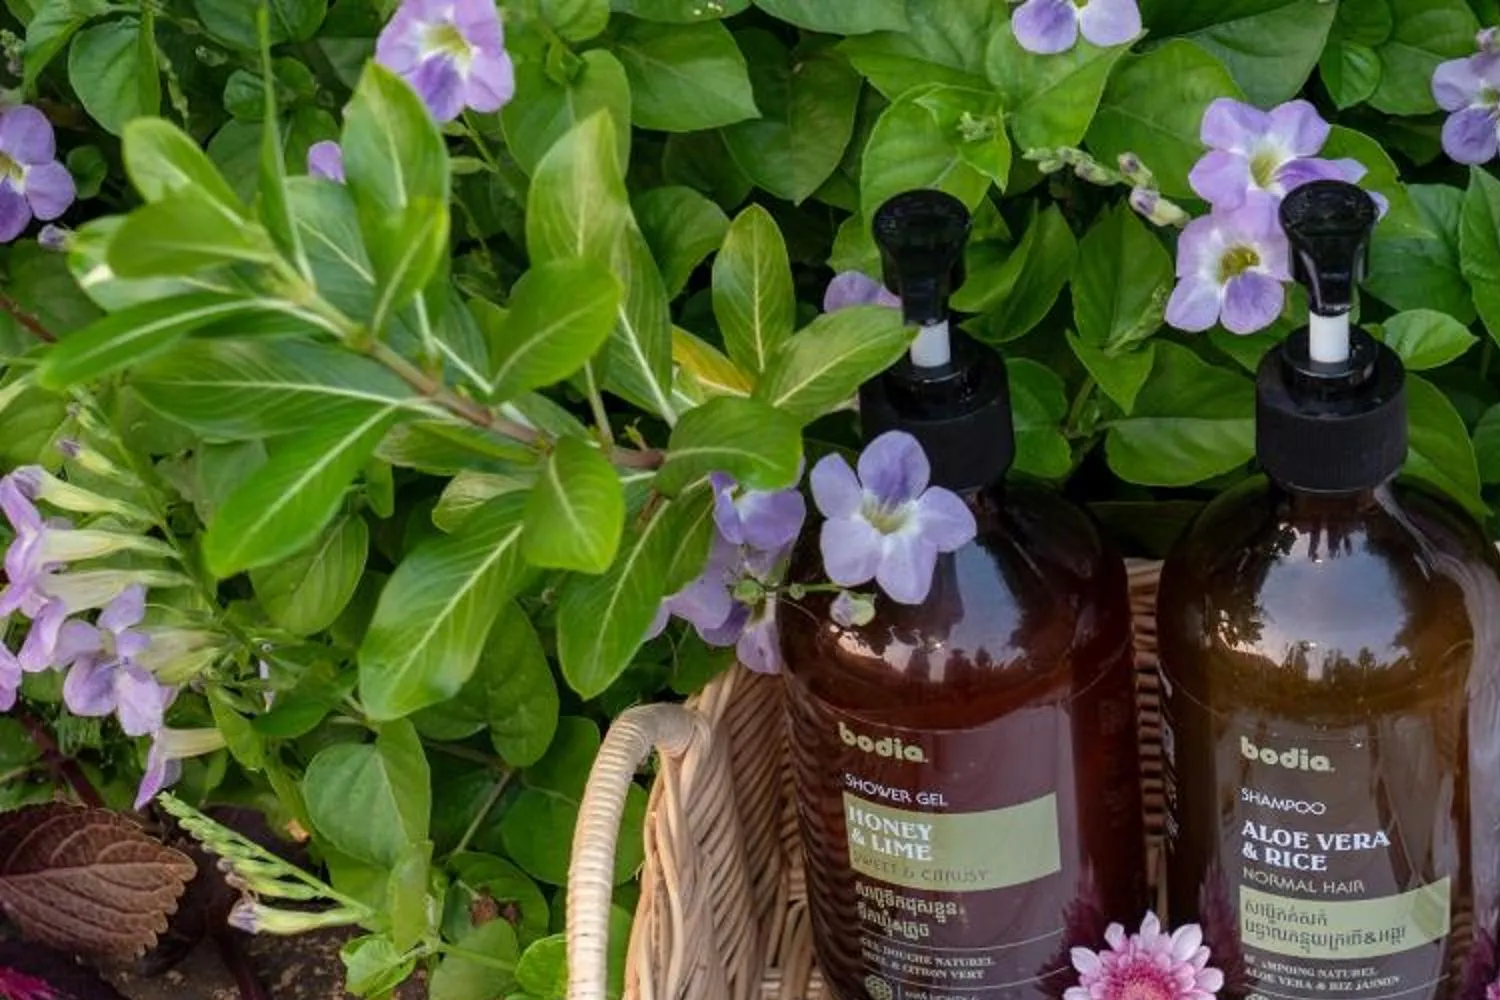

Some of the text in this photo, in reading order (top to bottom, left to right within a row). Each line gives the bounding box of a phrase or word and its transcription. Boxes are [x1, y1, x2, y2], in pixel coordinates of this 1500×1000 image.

[845, 773, 949, 807] SHOWER GEL
[1241, 788, 1327, 815] SHAMPOO
[849, 805, 933, 841] HONEY
[1241, 819, 1390, 851] ALOE VERA
[850, 827, 933, 862] & LIME
[1241, 841, 1328, 871] & RICE
[1243, 867, 1365, 894] NORMAL HAIR
[950, 970, 985, 979] VERT
[1278, 976, 1313, 990] VERA
